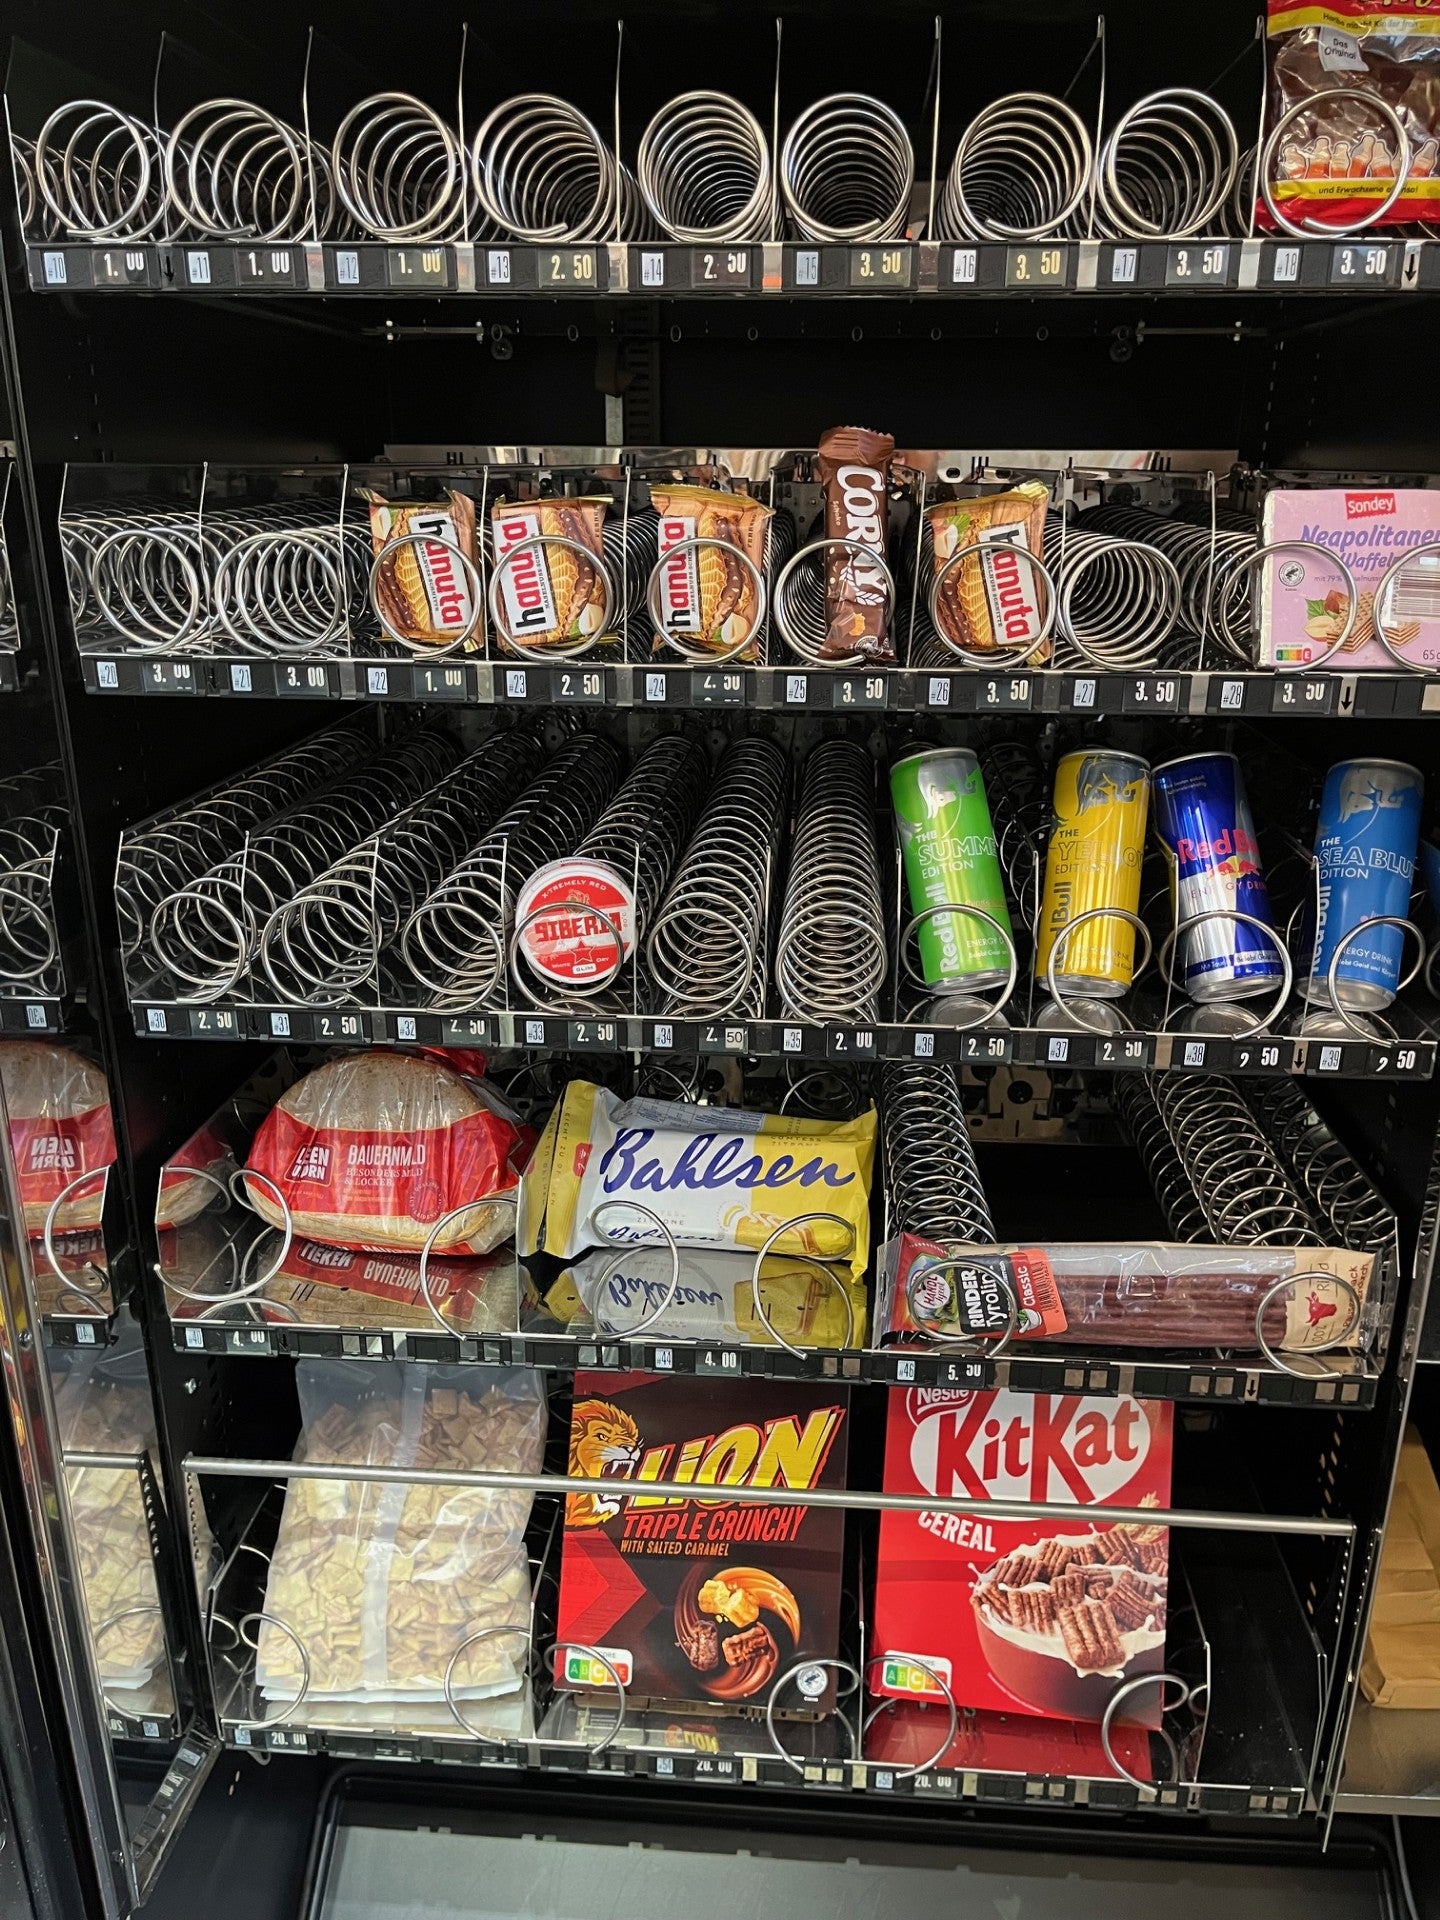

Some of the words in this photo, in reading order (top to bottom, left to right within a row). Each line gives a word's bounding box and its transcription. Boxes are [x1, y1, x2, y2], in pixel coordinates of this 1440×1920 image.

[1324, 47, 1357, 60] Original
[1333, 38, 1348, 49] Das
[1318, 185, 1334, 194] und
[341, 257, 358, 280] #12
[491, 256, 509, 278] #13
[644, 258, 662, 282] #14
[955, 255, 975, 278] #16
[1114, 254, 1134, 277] #17
[1277, 253, 1297, 275] #18
[1347, 497, 1394, 516] Sondey
[418, 519, 463, 625] hanuta
[499, 520, 547, 628] hanuta
[661, 521, 691, 627] hanuta
[989, 529, 1034, 639] hanuta
[509, 675, 525, 693] #23
[648, 679, 664, 697] #24
[788, 679, 805, 698] #25
[1076, 683, 1093, 702] #27
[915, 829, 937, 843] THE
[1059, 829, 1080, 839] THE
[1320, 836, 1341, 848] THE
[1176, 828, 1232, 864] Red
[1319, 846, 1365, 868] SEA
[922, 859, 975, 880] EDITION
[1320, 867, 1369, 880] DITION
[589, 880, 607, 891] RED
[1051, 882, 1072, 923] Bull
[933, 927, 961, 973] Red
[1370, 951, 1394, 965] DRINK
[599, 1126, 856, 1194] Bahlsen
[346, 1168, 401, 1178] BESONDERS
[355, 1177, 393, 1186] LOCKER
[923, 1275, 938, 1305] HANDL
[1017, 1266, 1036, 1307] Classic
[960, 1269, 986, 1328] RINDER
[935, 1388, 1140, 1507] KitKat
[625, 1405, 846, 1513] LION
[623, 1511, 708, 1541] TRIPLE
[706, 1505, 808, 1542] CRUNCHY
[917, 1511, 997, 1553] CEREAL
[620, 1539, 645, 1553] WITH
[646, 1540, 682, 1555] SALTED
[684, 1541, 731, 1556] CARAMEL
[593, 1663, 604, 1678] C
[910, 1670, 921, 1685] C
